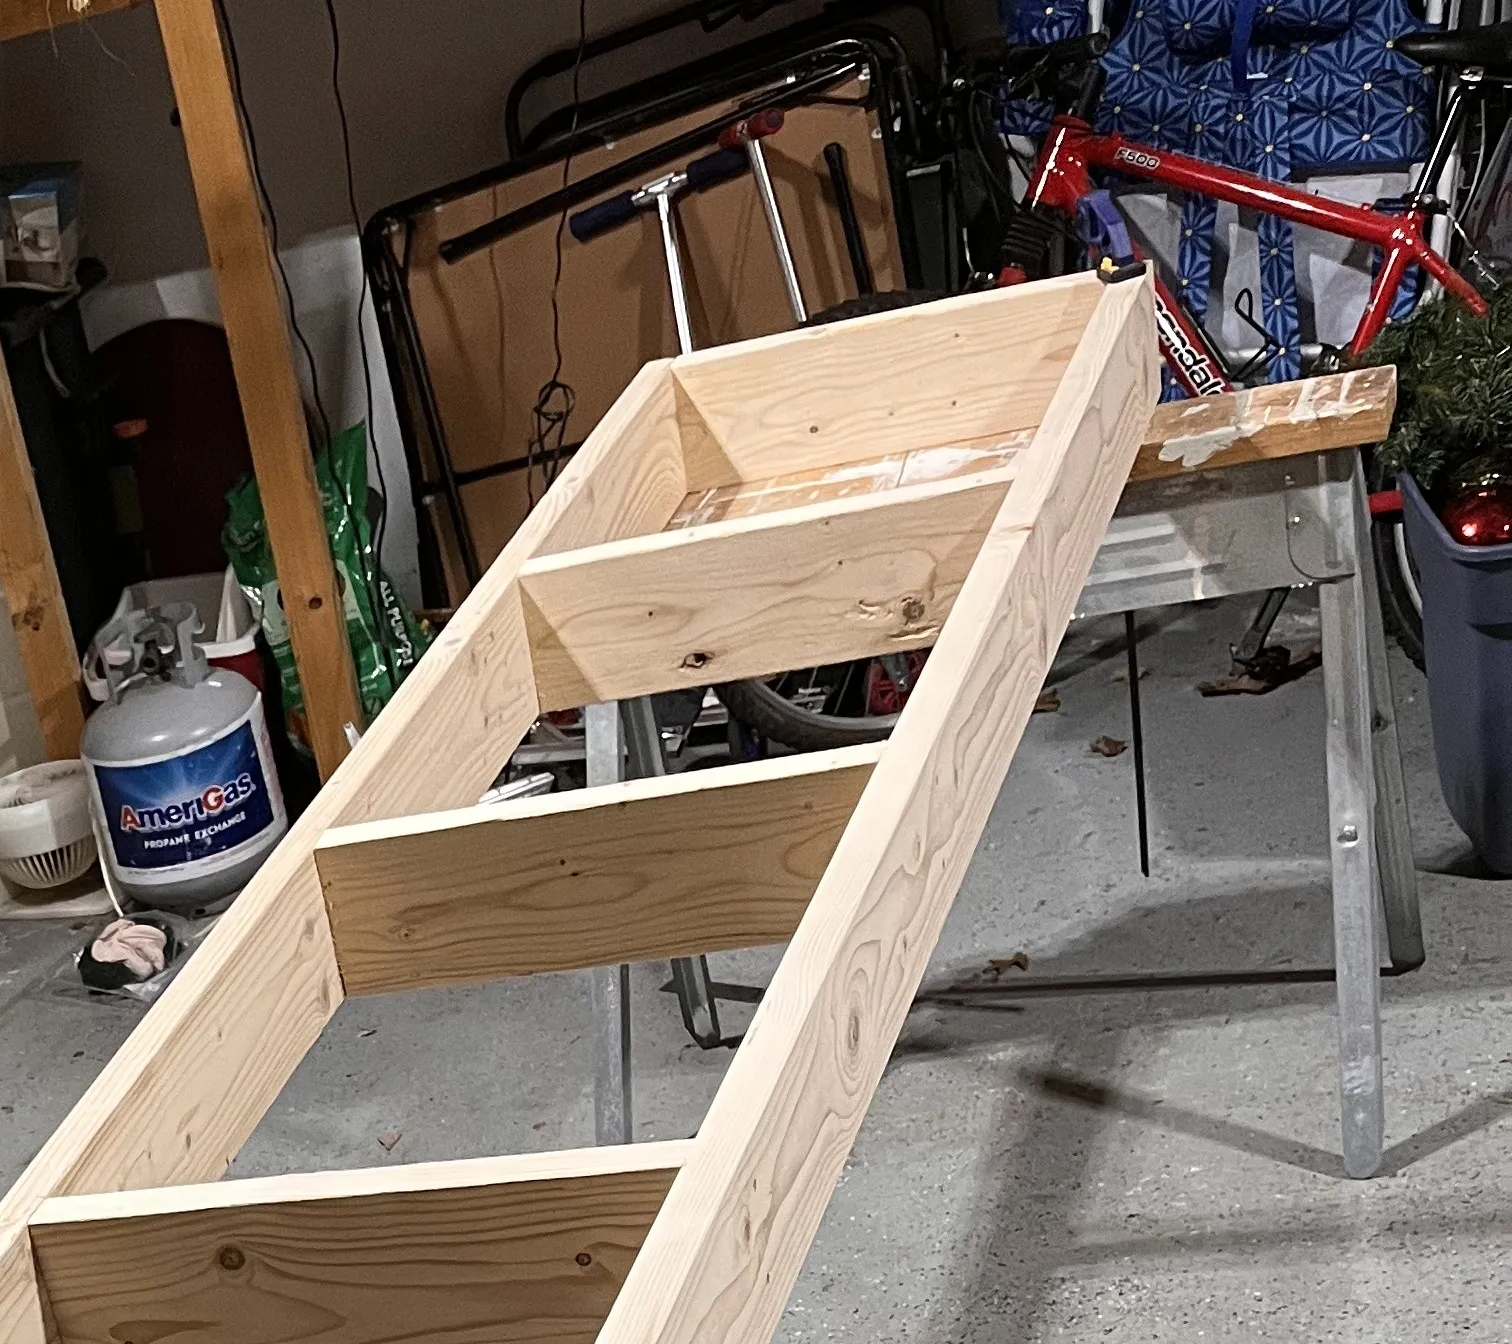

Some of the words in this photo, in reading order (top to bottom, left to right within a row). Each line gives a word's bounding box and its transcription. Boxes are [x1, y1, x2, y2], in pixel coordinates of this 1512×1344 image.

[1114, 147, 1161, 170] F500
[120, 772, 256, 832] AmeriGas
[144, 832, 191, 850] PROPANE
[194, 811, 246, 840] EXCHANGE
